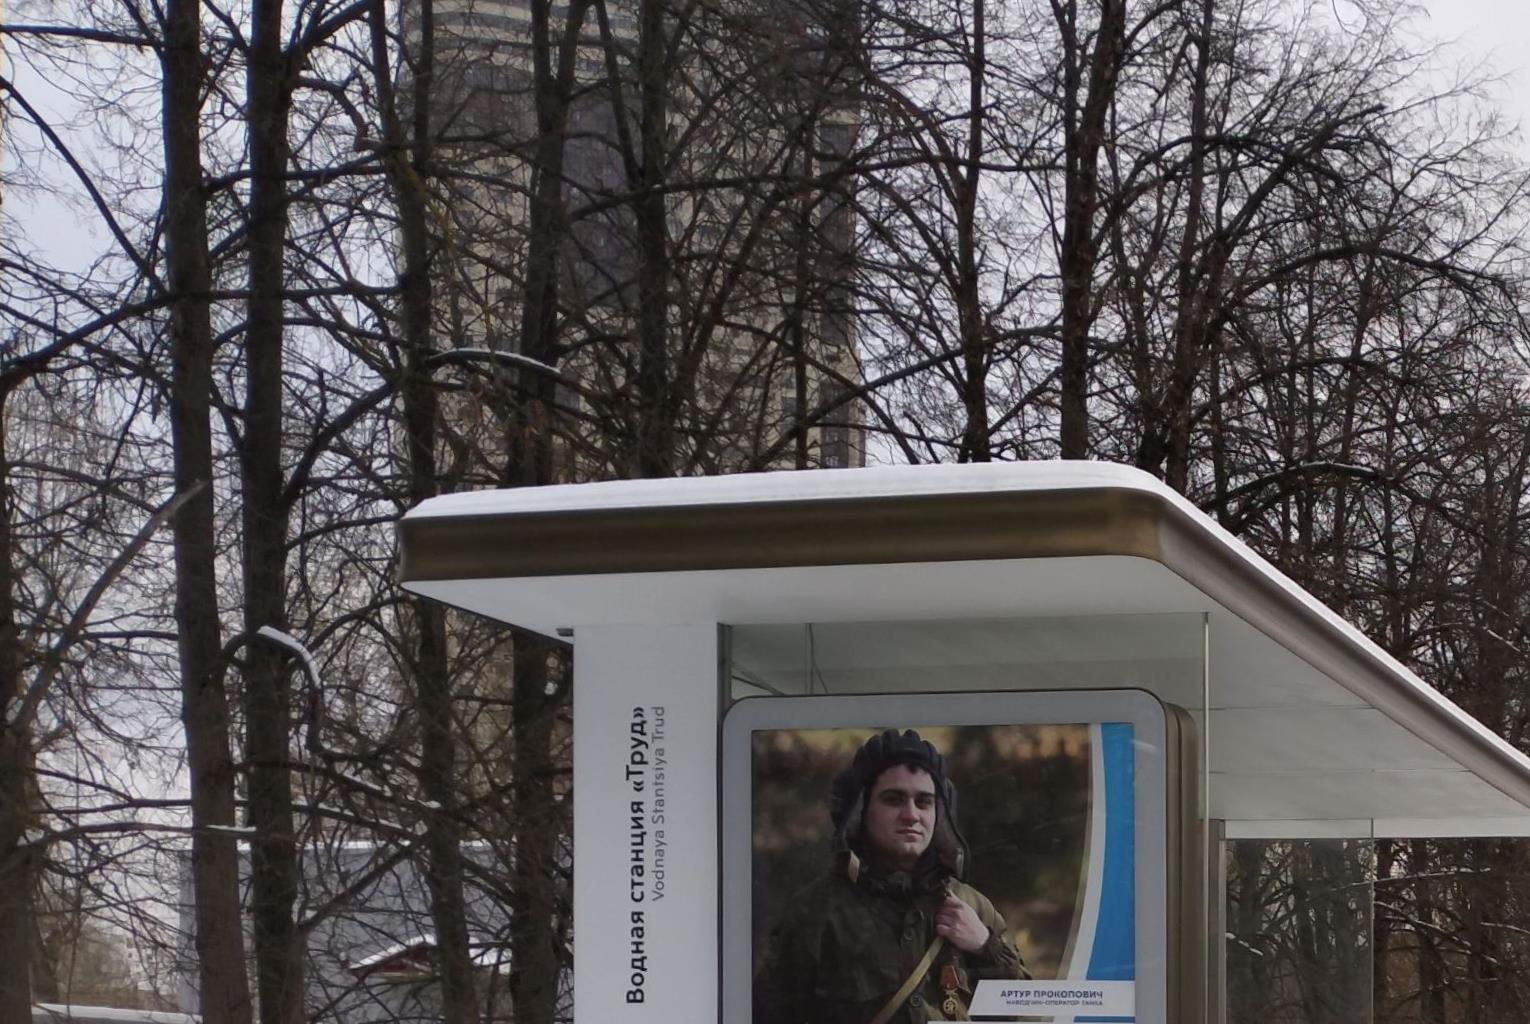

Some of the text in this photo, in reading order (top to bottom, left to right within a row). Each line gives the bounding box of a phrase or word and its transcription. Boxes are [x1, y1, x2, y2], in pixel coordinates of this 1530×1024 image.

[626, 706, 649, 1004] Водная станция «Труд»
[652, 706, 668, 902] Vodnaya Stantsiya Trud
[1000, 989, 1103, 999] АРТУР ПРОКОПОВИЧ
